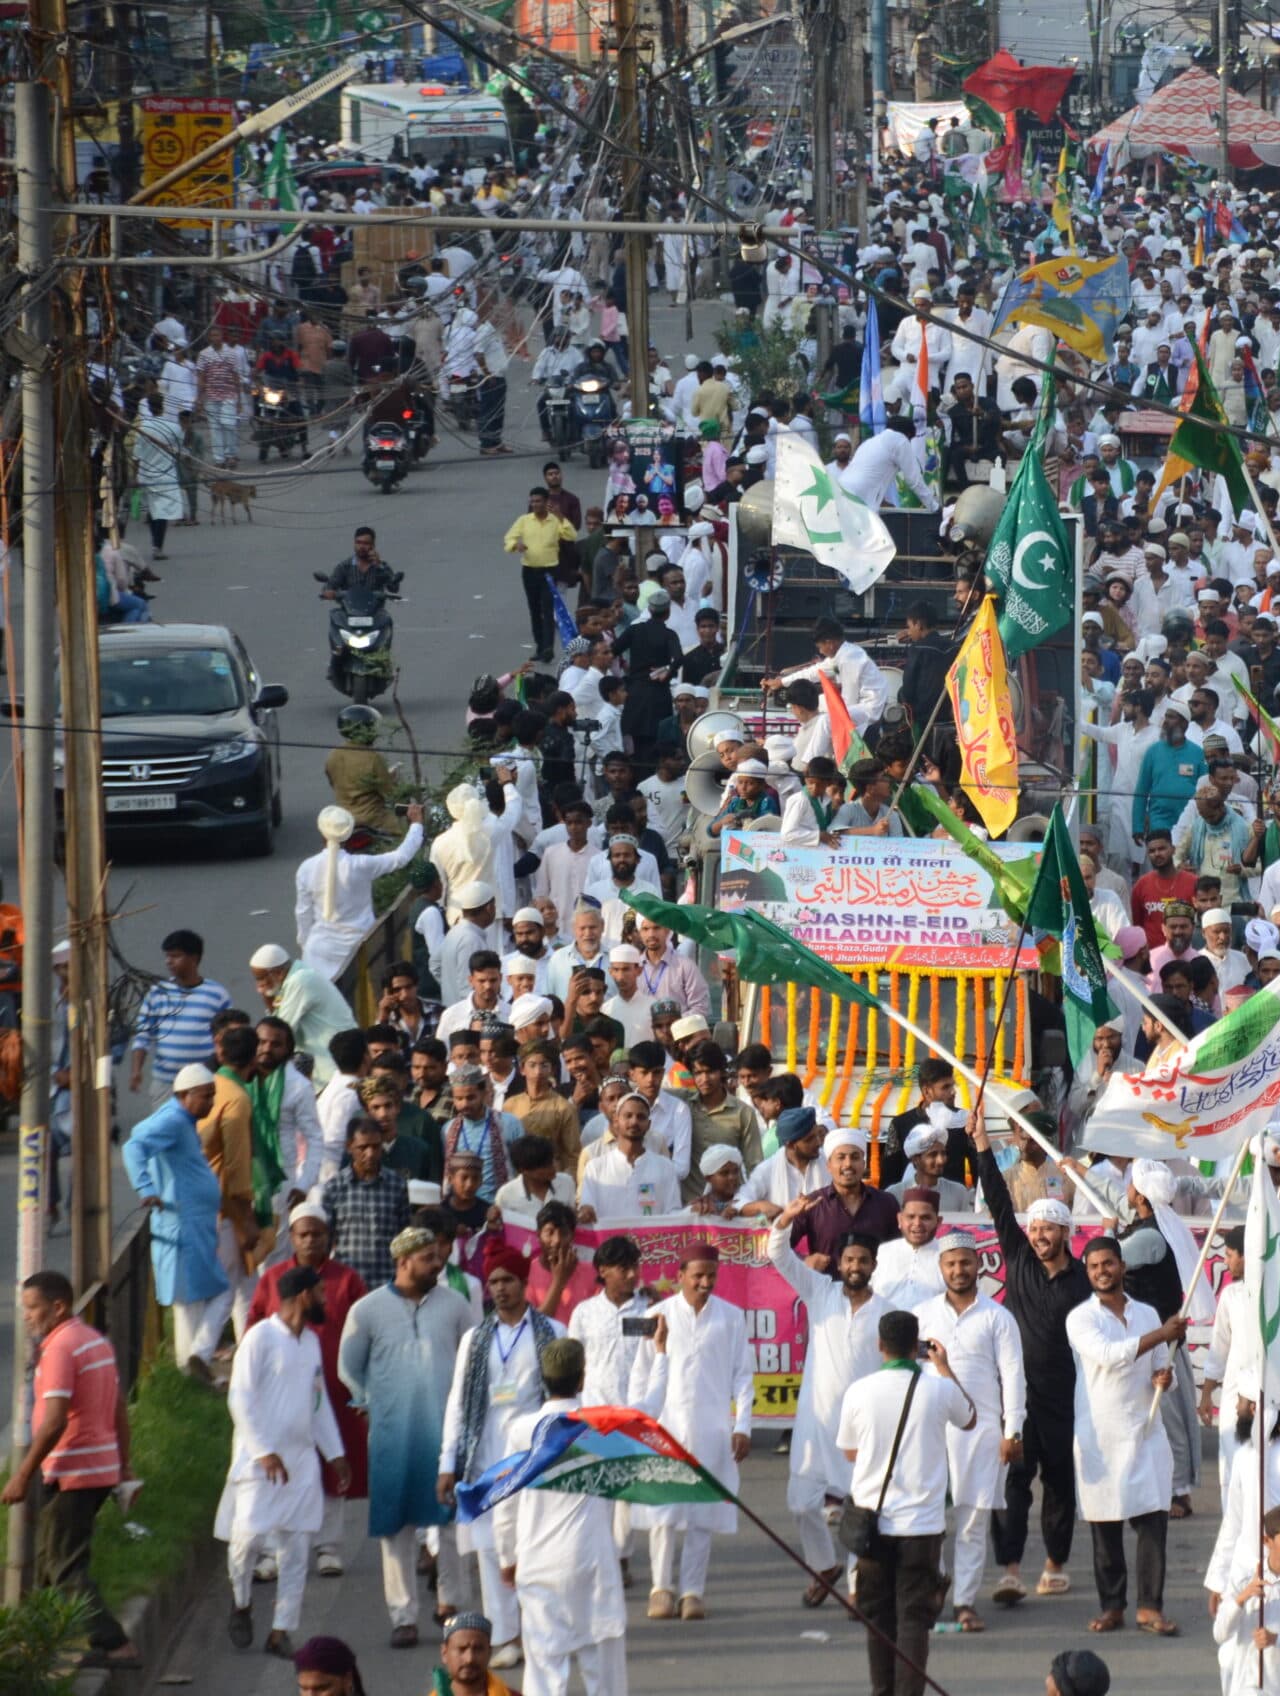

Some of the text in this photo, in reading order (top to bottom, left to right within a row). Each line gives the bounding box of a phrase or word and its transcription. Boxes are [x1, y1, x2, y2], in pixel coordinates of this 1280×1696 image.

[154, 139, 177, 153] 35
[828, 855, 875, 866] 1500
[810, 912, 968, 930] JASHN-E-EID
[793, 926, 982, 946] MILADUN NABI
